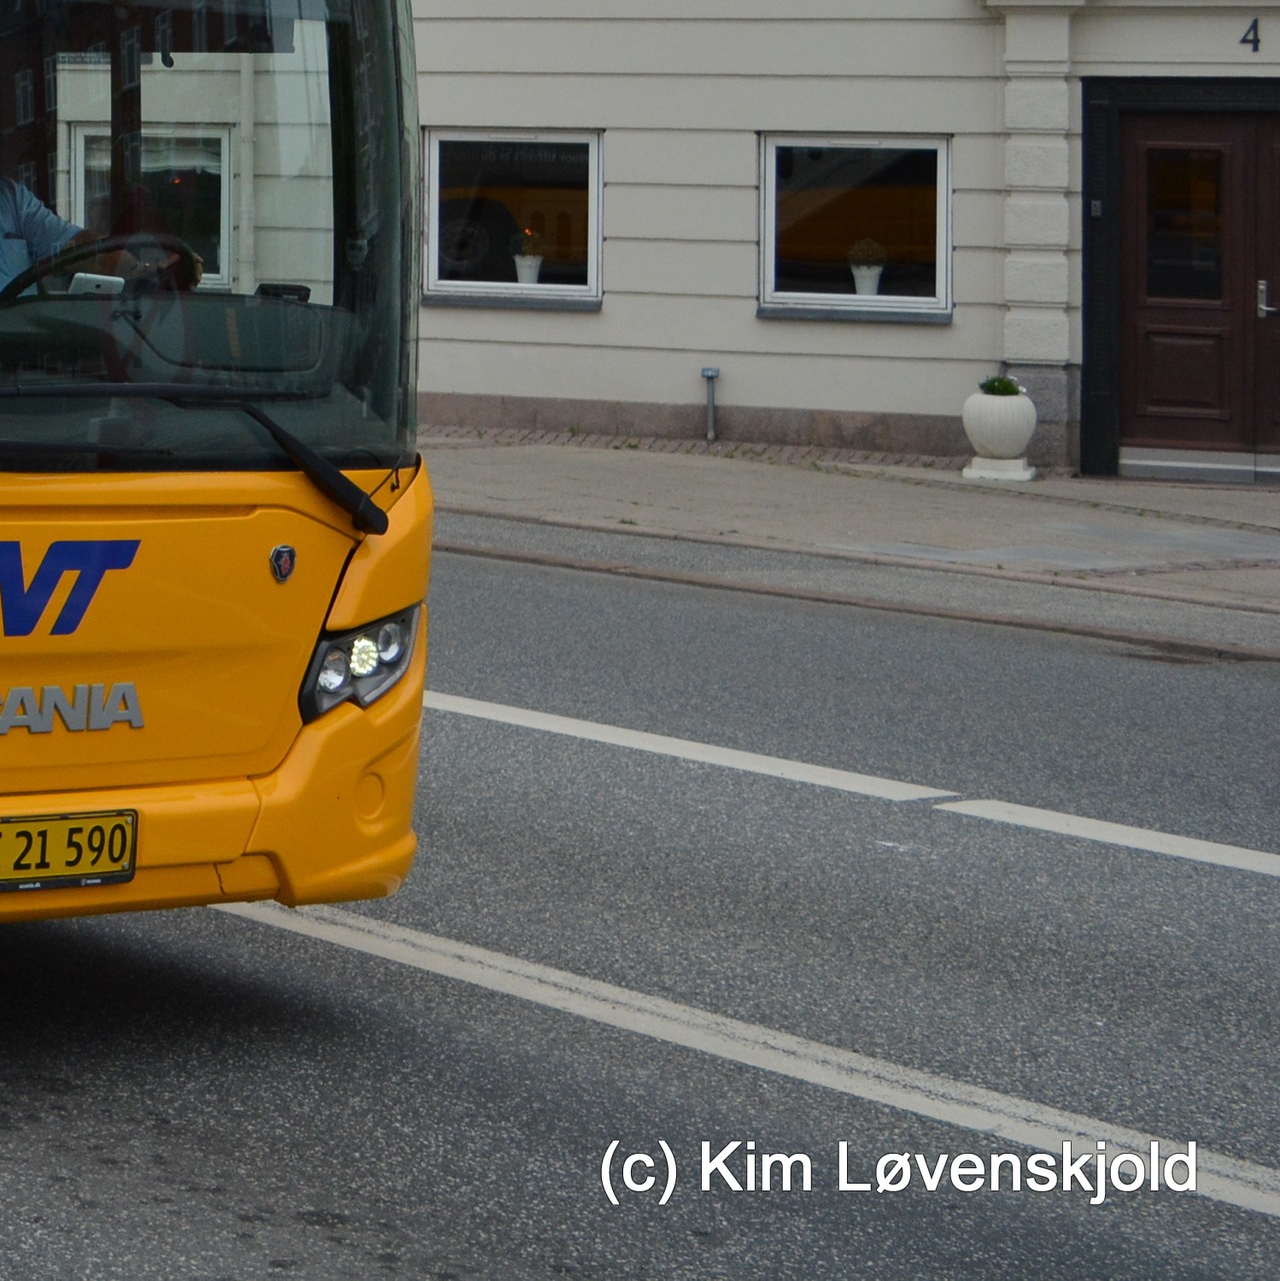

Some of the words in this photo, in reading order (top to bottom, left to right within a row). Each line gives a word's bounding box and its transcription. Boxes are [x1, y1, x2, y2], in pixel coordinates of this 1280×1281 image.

[1239, 18, 1260, 52] 4
[13, 829, 50, 870] 21
[65, 823, 127, 866] 590
